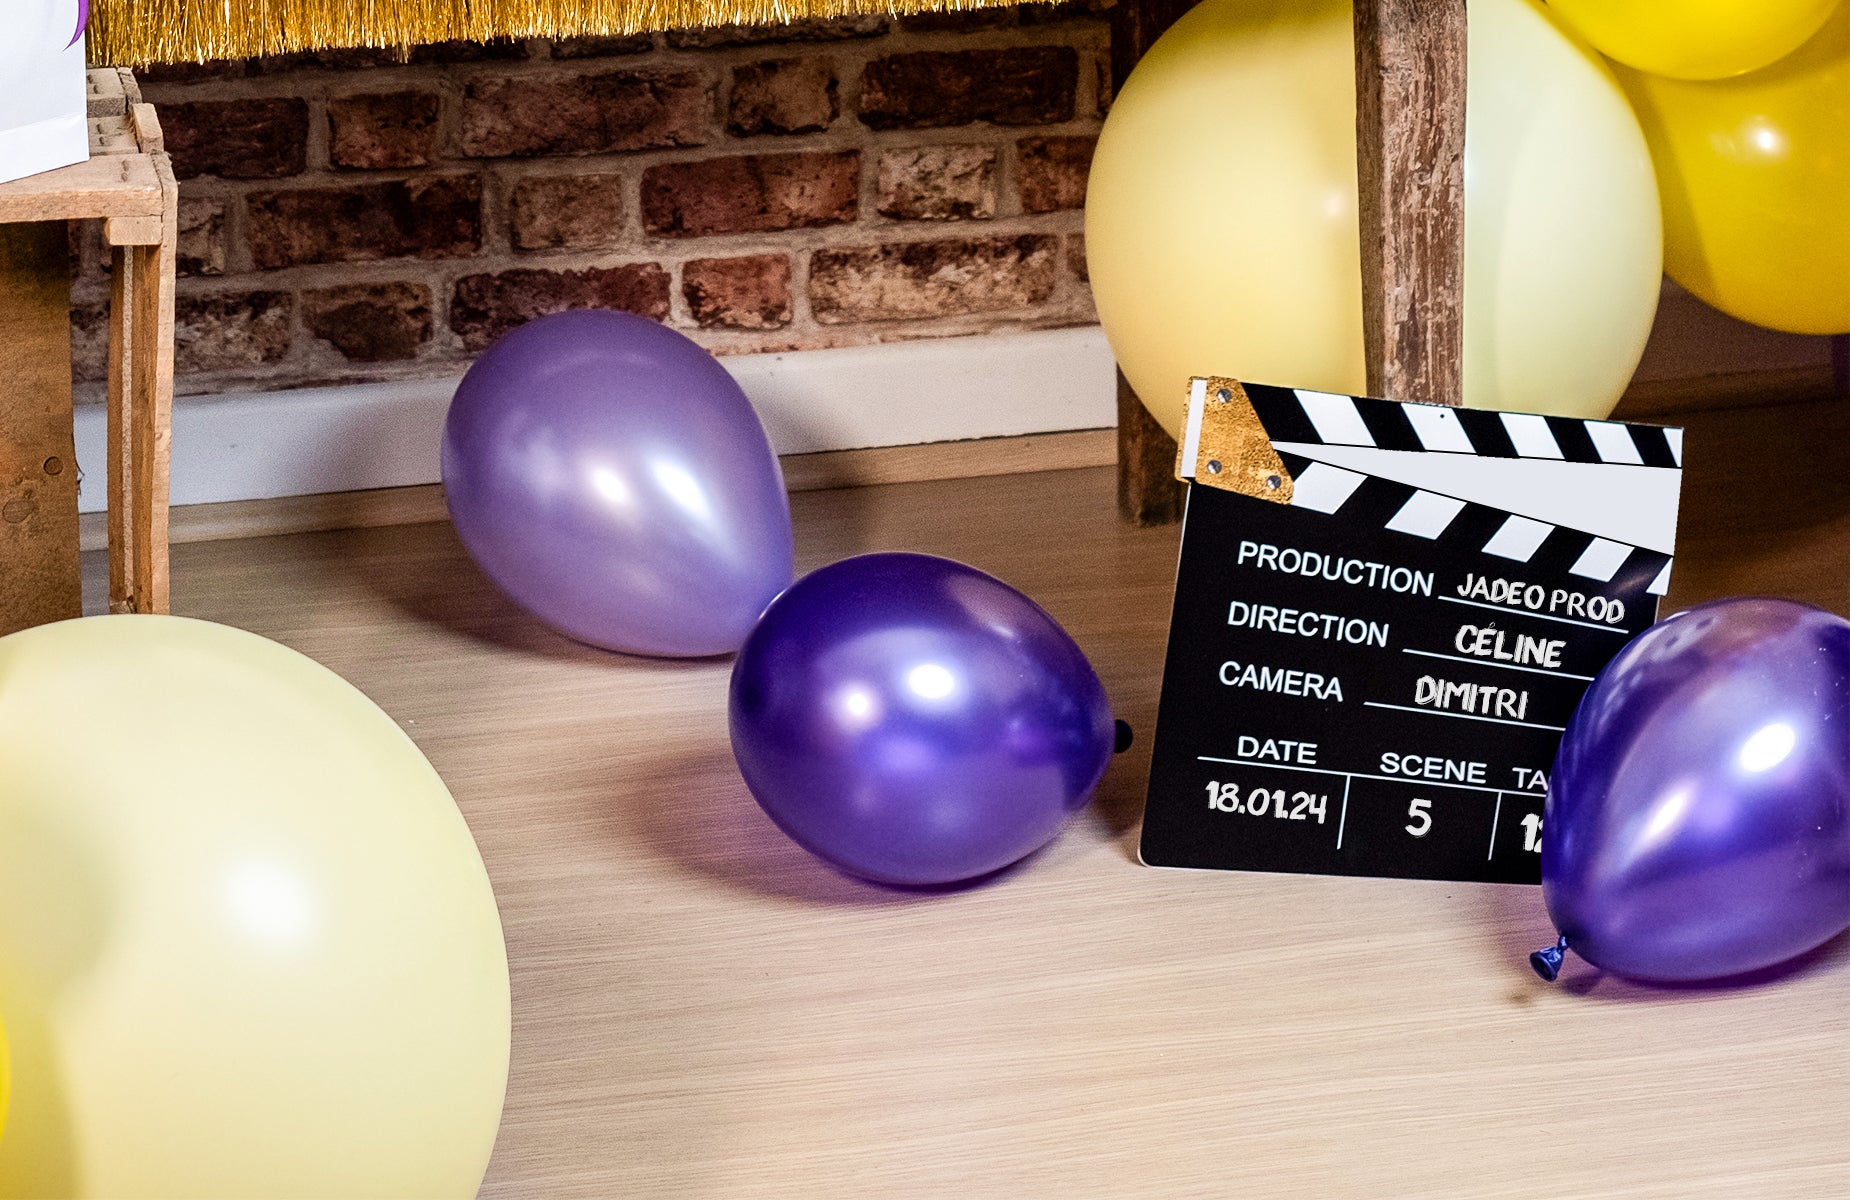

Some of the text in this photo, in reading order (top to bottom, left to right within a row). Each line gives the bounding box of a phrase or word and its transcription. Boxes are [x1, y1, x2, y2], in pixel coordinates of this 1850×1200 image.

[1237, 540, 1626, 624] PRODUCTION JADEO PROD
[1227, 601, 1567, 668] DIRECTION CÉLINE
[1218, 661, 1530, 720] CAMERA DIMITRI
[1237, 735, 1549, 791] DATE SCENE TA
[1205, 780, 1328, 825] 18.01.24
[1404, 798, 1432, 838] 5
